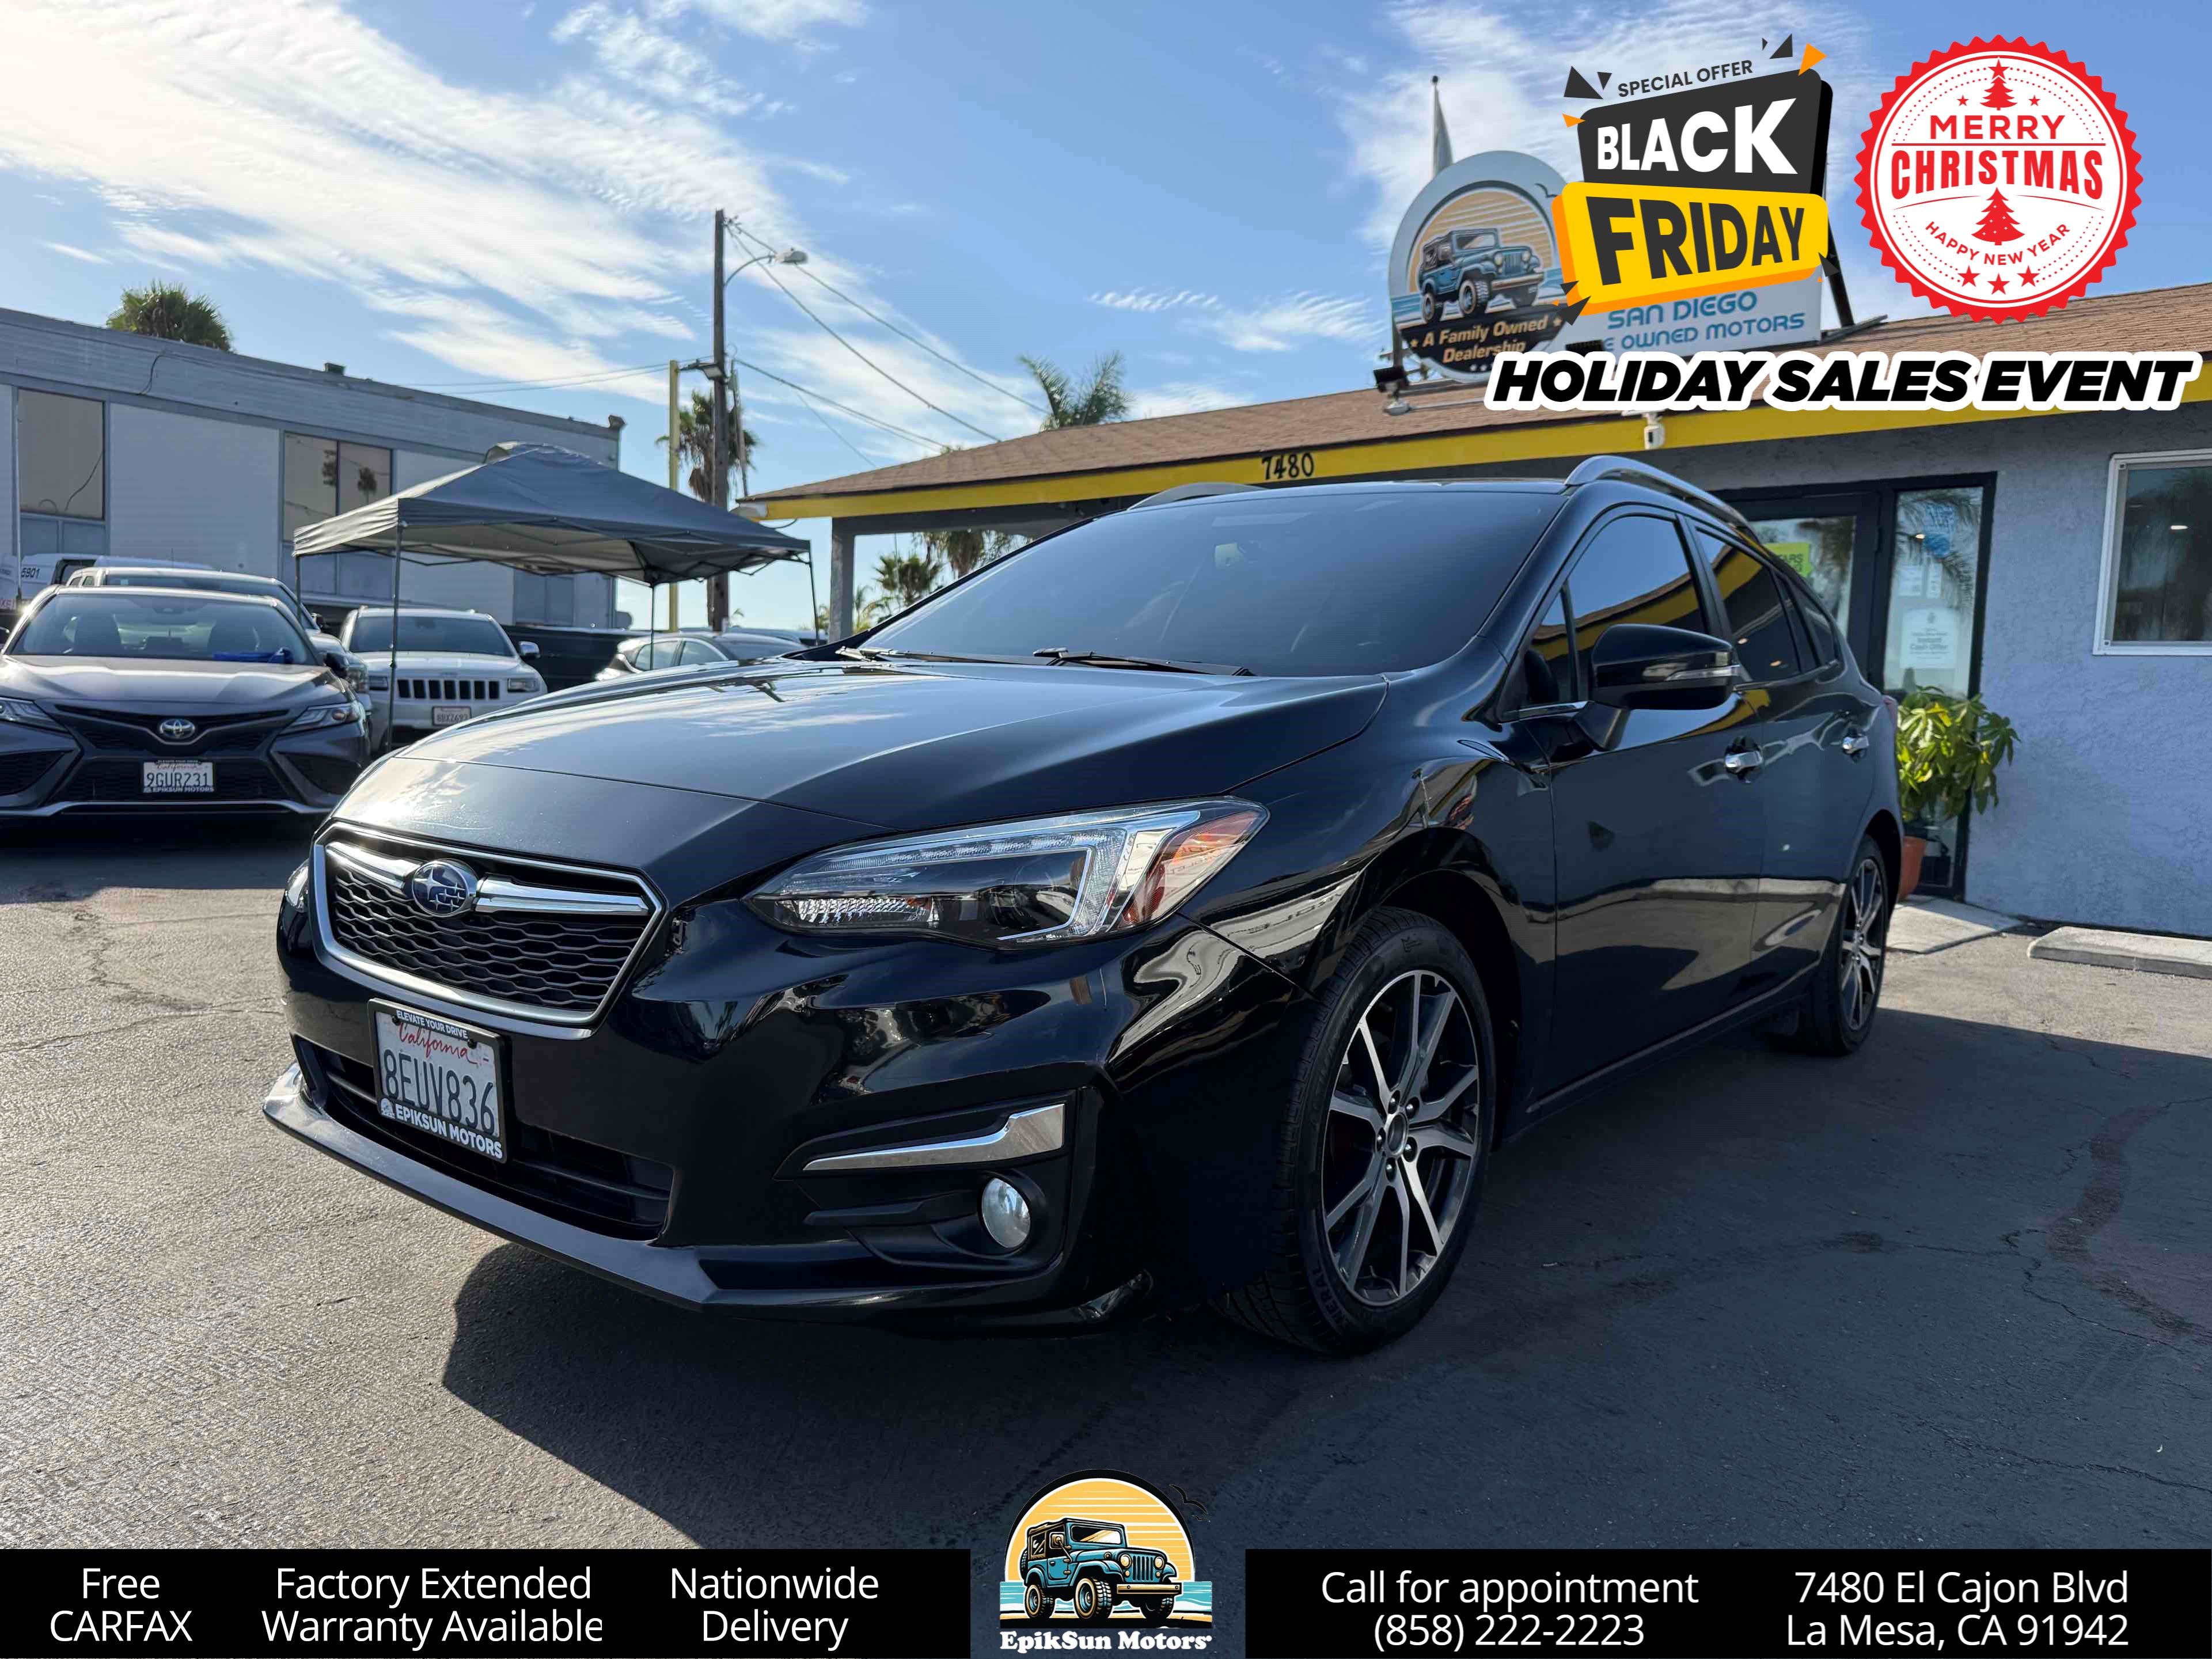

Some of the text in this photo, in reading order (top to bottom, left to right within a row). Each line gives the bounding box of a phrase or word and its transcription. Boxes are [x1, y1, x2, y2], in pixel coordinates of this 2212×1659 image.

[1607, 291, 1757, 329] SAN DIEGO
[1423, 314, 1548, 347] A Family Owned
[1621, 327, 1698, 351] OWNED
[1706, 313, 1805, 340] MOTORS
[1443, 339, 1526, 363] Dealership
[1262, 452, 1314, 480] 7480
[146, 772, 207, 788] 9GUR231
[396, 1009, 468, 1039] ELEVATE YOUR DRIVE
[399, 1022, 478, 1064] California
[384, 1049, 494, 1136] 8EUV836
[395, 1104, 503, 1159] EPIKSUN MOTORS
